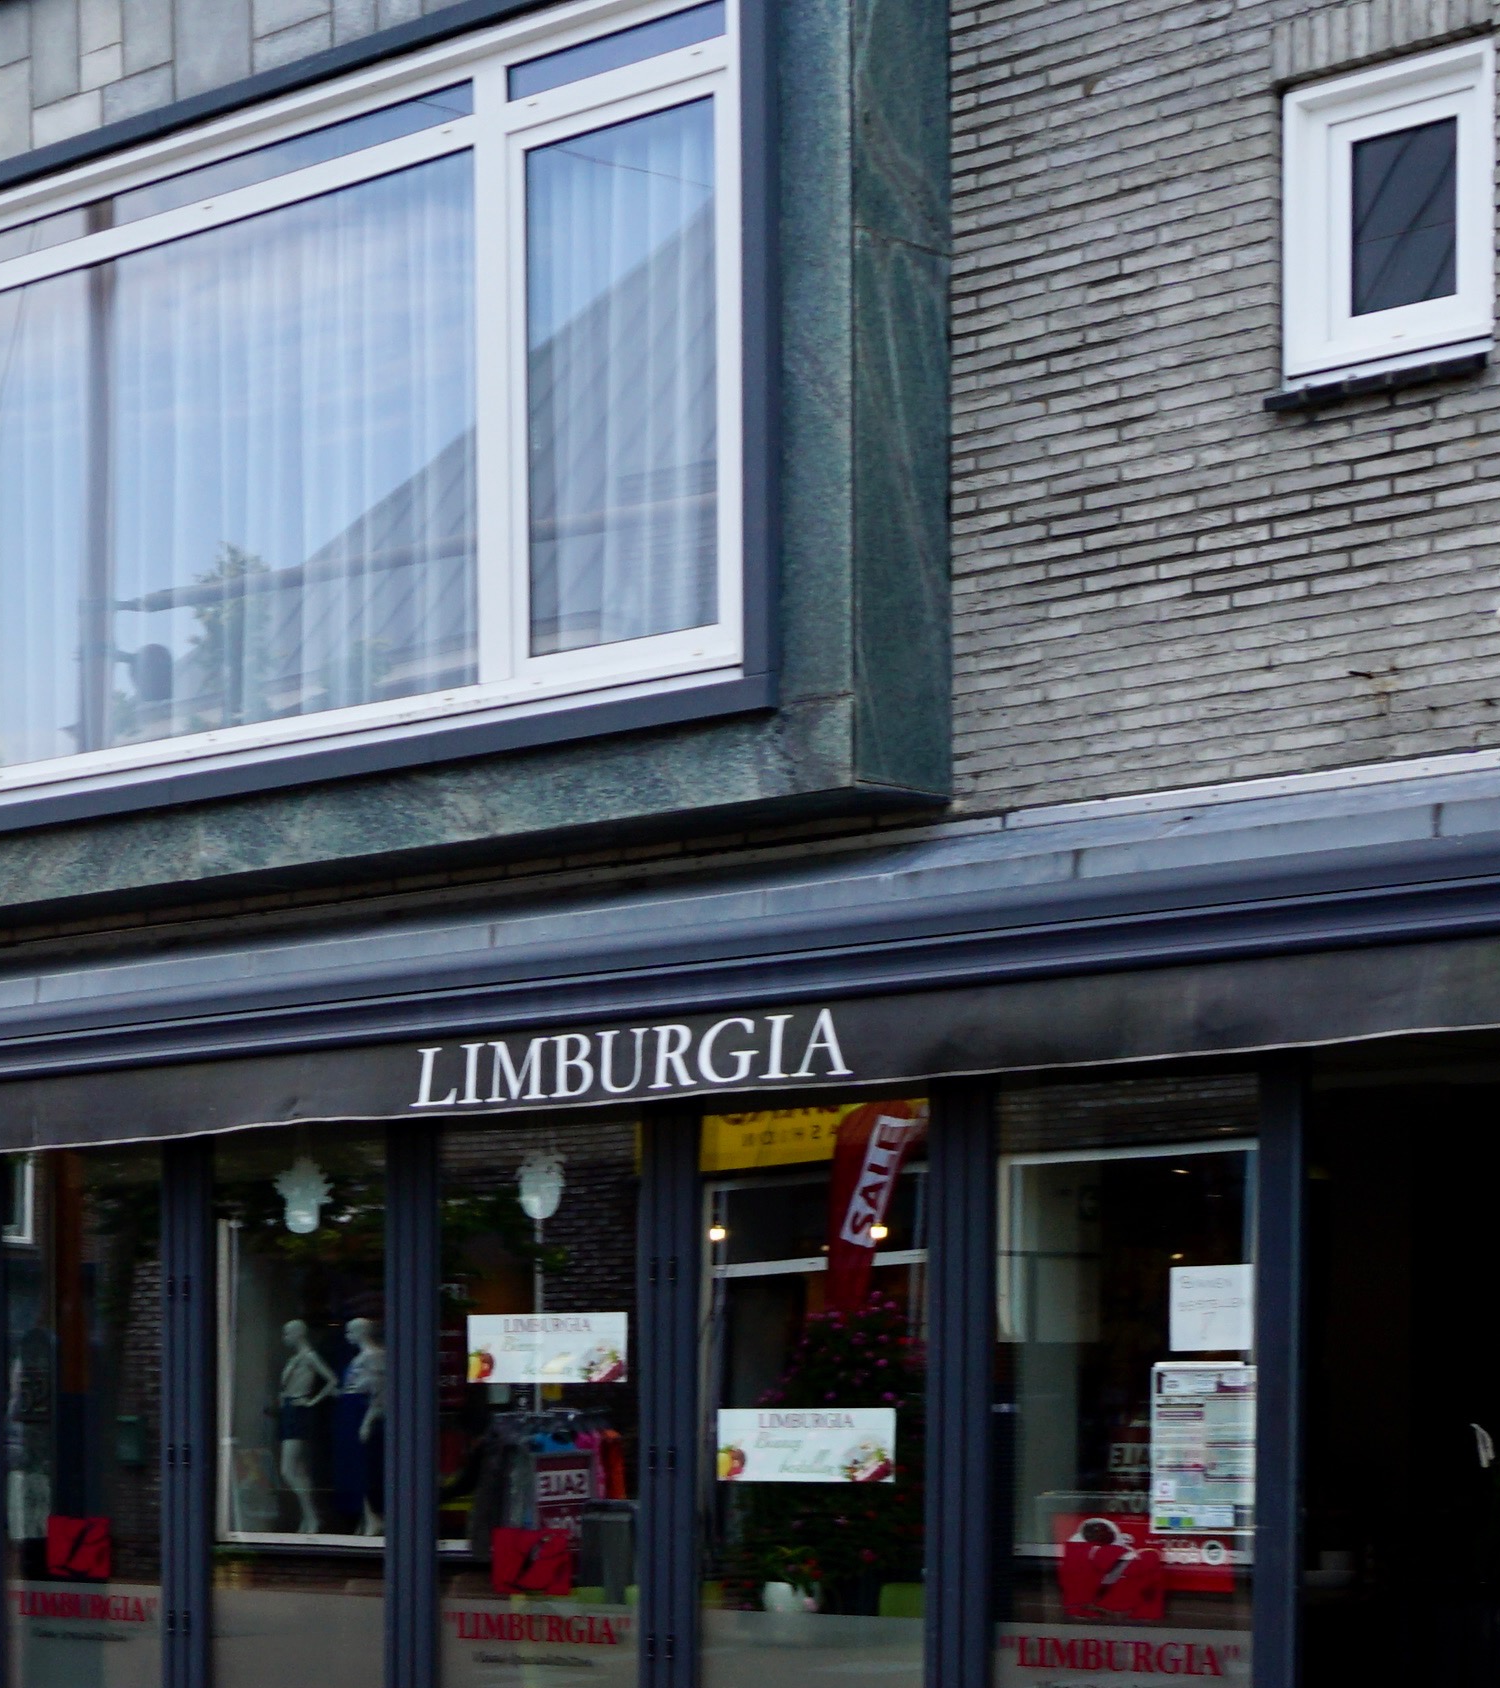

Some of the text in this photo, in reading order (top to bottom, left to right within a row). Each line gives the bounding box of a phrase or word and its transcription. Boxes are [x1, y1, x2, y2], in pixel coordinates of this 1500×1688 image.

[410, 1008, 854, 1107] LIMBURGIA
[503, 1317, 593, 1333] LIMBURGIA
[757, 1413, 855, 1429] LIMBURGIA
